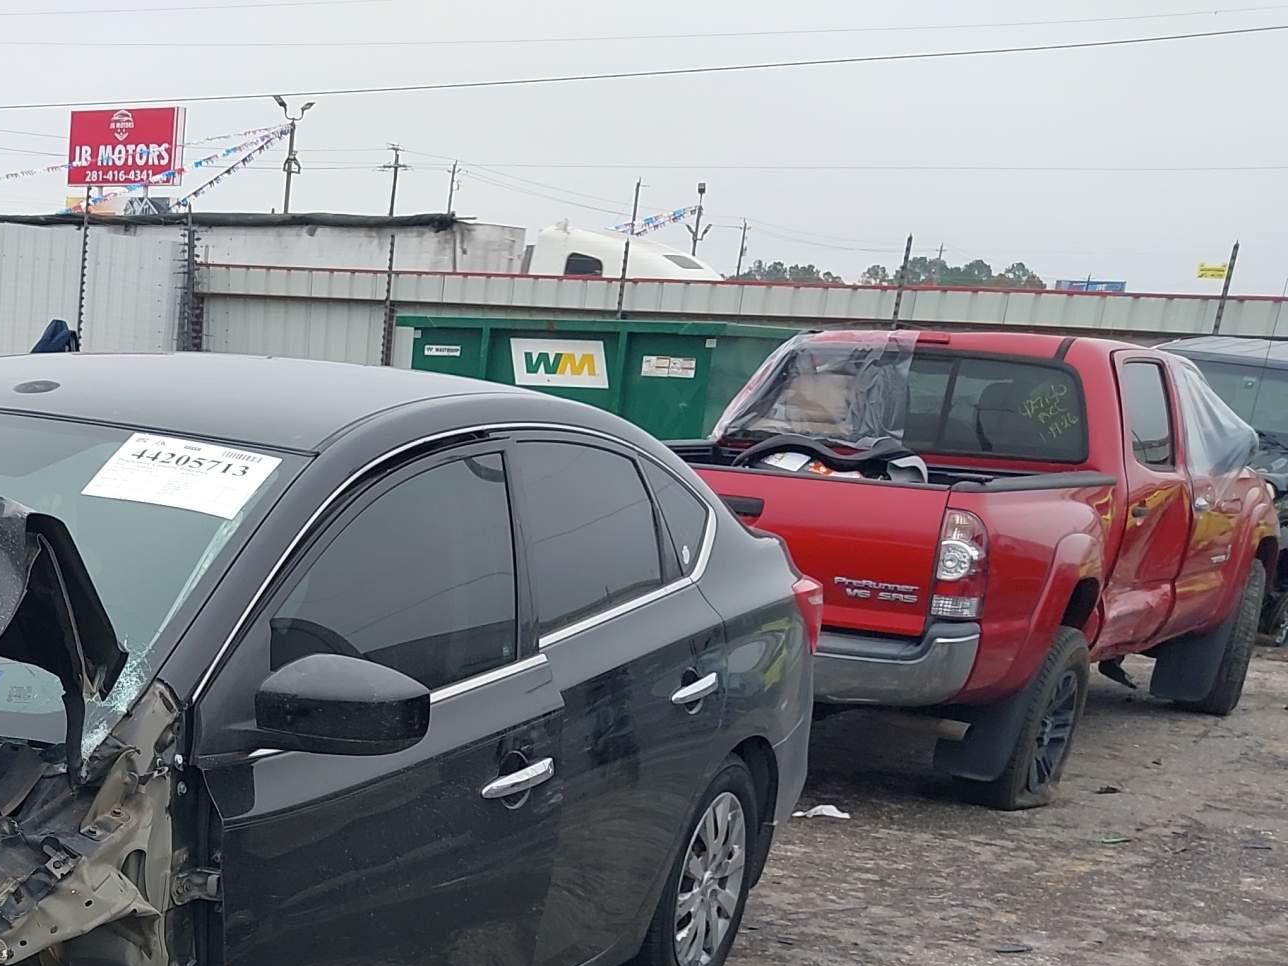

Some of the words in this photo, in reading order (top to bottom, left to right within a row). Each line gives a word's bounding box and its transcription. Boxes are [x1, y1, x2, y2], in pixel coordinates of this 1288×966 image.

[73, 145, 92, 167] JB
[97, 143, 171, 167] MOTORS
[85, 169, 153, 182] 281-416-4341
[524, 351, 597, 377] WM
[131, 449, 250, 477] 44205713
[834, 576, 920, 592] PreRunner
[845, 588, 871, 599] V6
